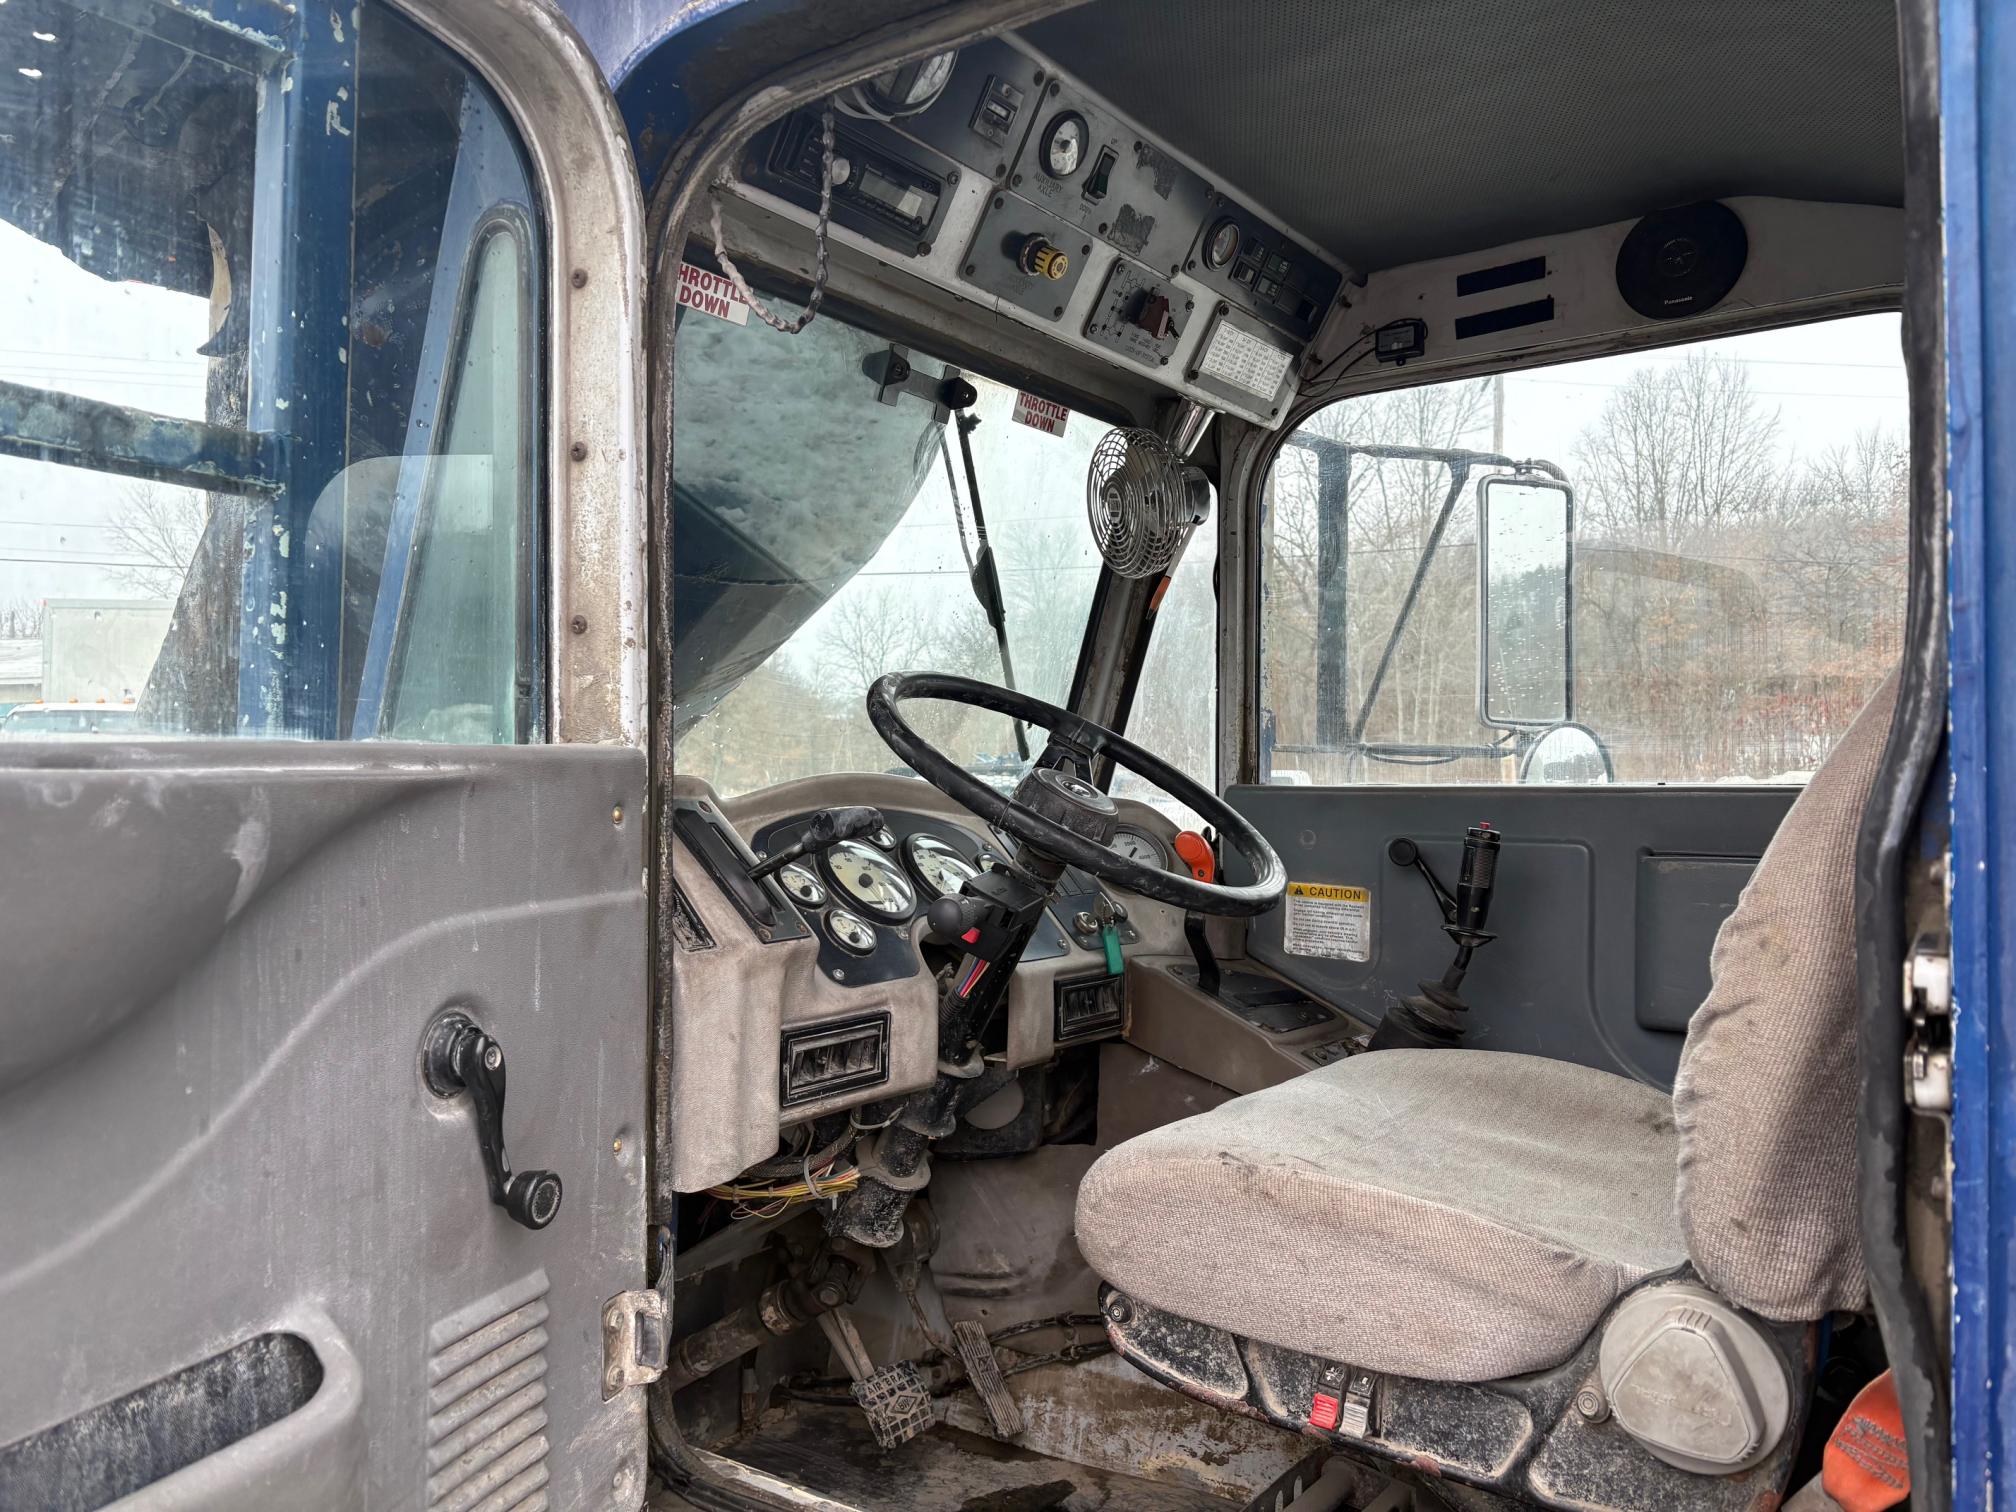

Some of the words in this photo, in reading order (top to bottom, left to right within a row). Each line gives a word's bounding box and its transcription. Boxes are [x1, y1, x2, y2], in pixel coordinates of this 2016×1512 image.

[678, 263, 749, 305] HROTTL
[679, 285, 731, 318] DOWN
[1664, 295, 1693, 305] Panasonic
[1019, 392, 1068, 421] THROTTLE
[1024, 411, 1055, 432] DOWN
[1309, 887, 1361, 899] CAUTION
